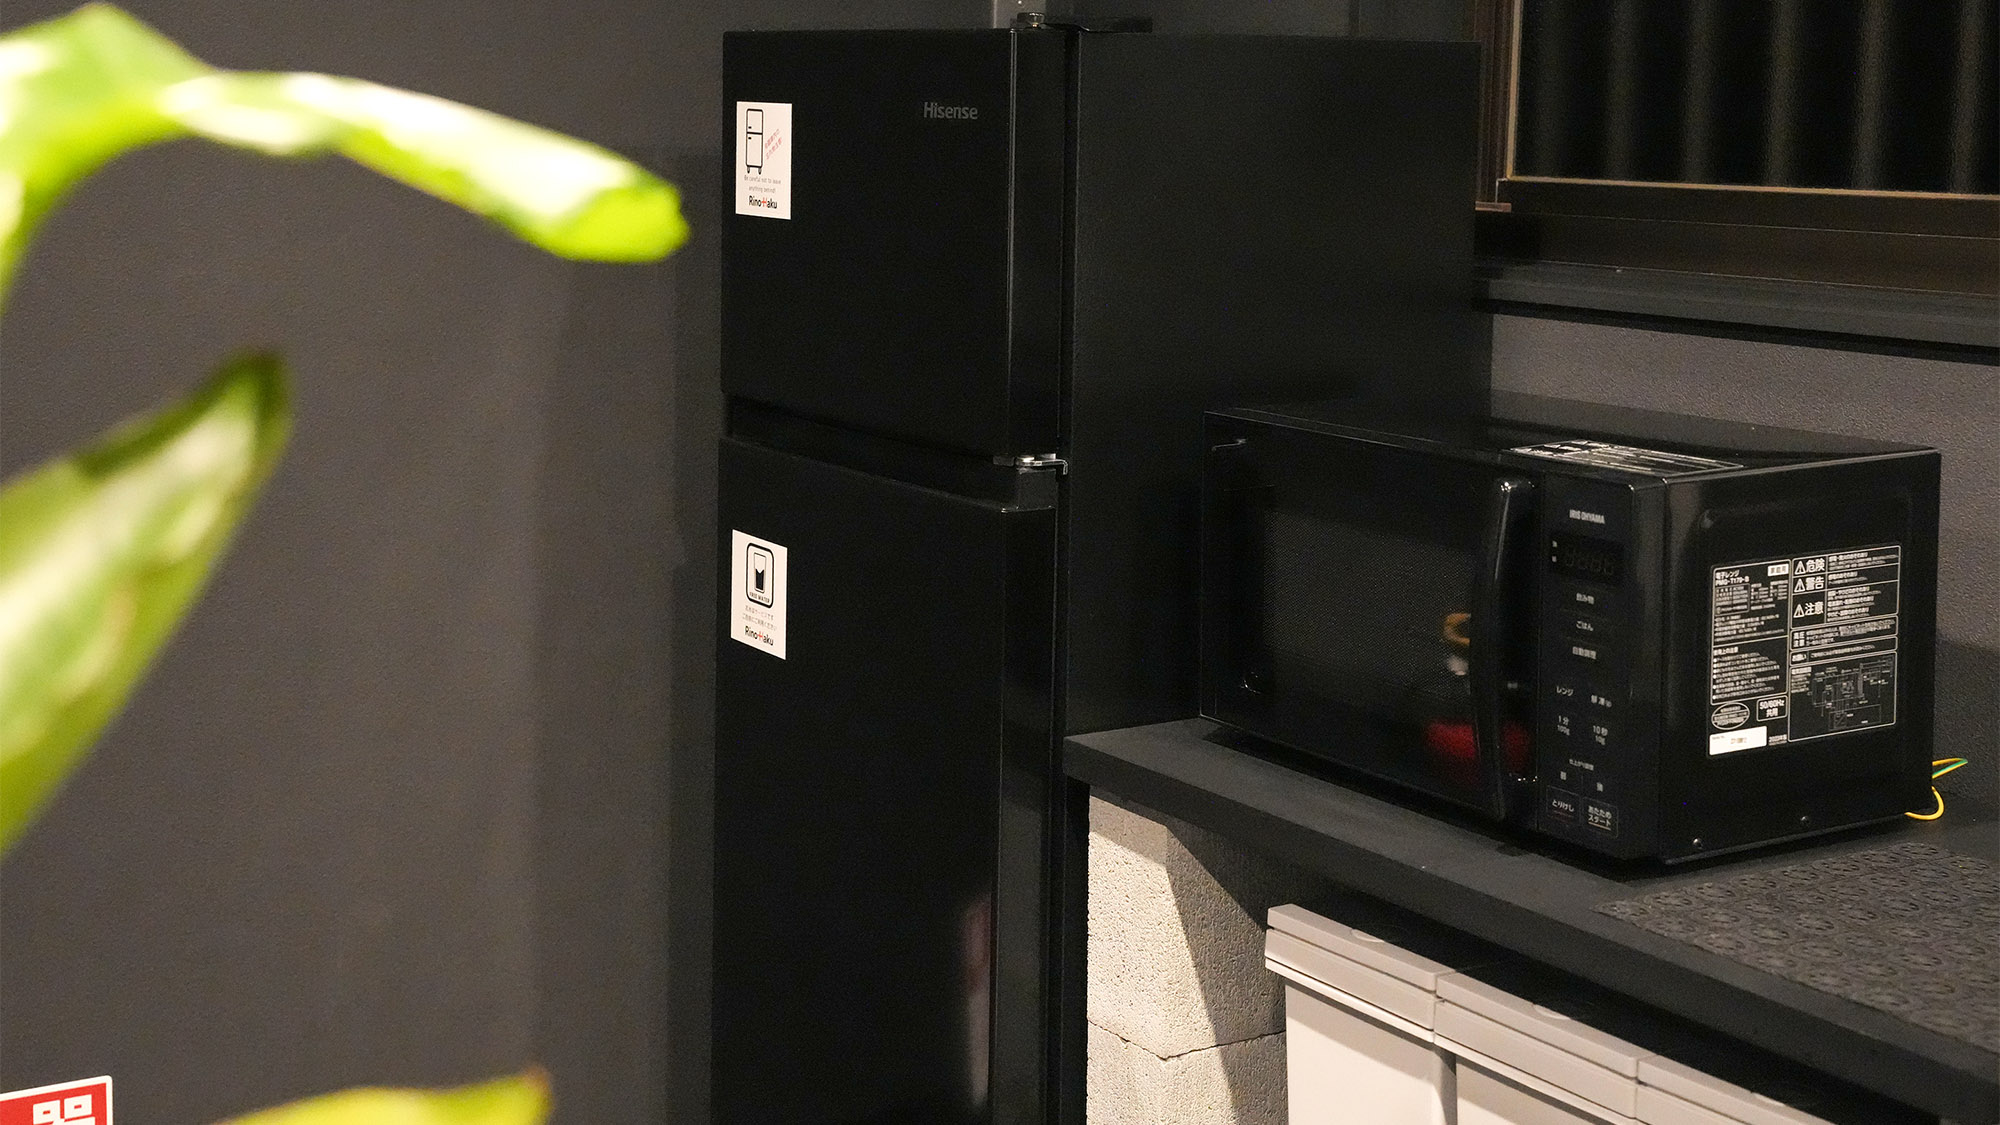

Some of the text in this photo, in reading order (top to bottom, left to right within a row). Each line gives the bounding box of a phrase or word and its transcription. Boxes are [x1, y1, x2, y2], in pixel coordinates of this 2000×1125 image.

[923, 101, 978, 120] Hisense
[1805, 558, 1825, 573] 危険
[1805, 575, 1825, 591] 警告
[1805, 601, 1824, 616] 注意
[1556, 685, 1574, 697] レンジ
[1759, 698, 1785, 710] 50/60Hz
[1552, 799, 1575, 812] とりけし
[1588, 805, 1612, 819] あたため
[1588, 813, 1611, 827] スタート
